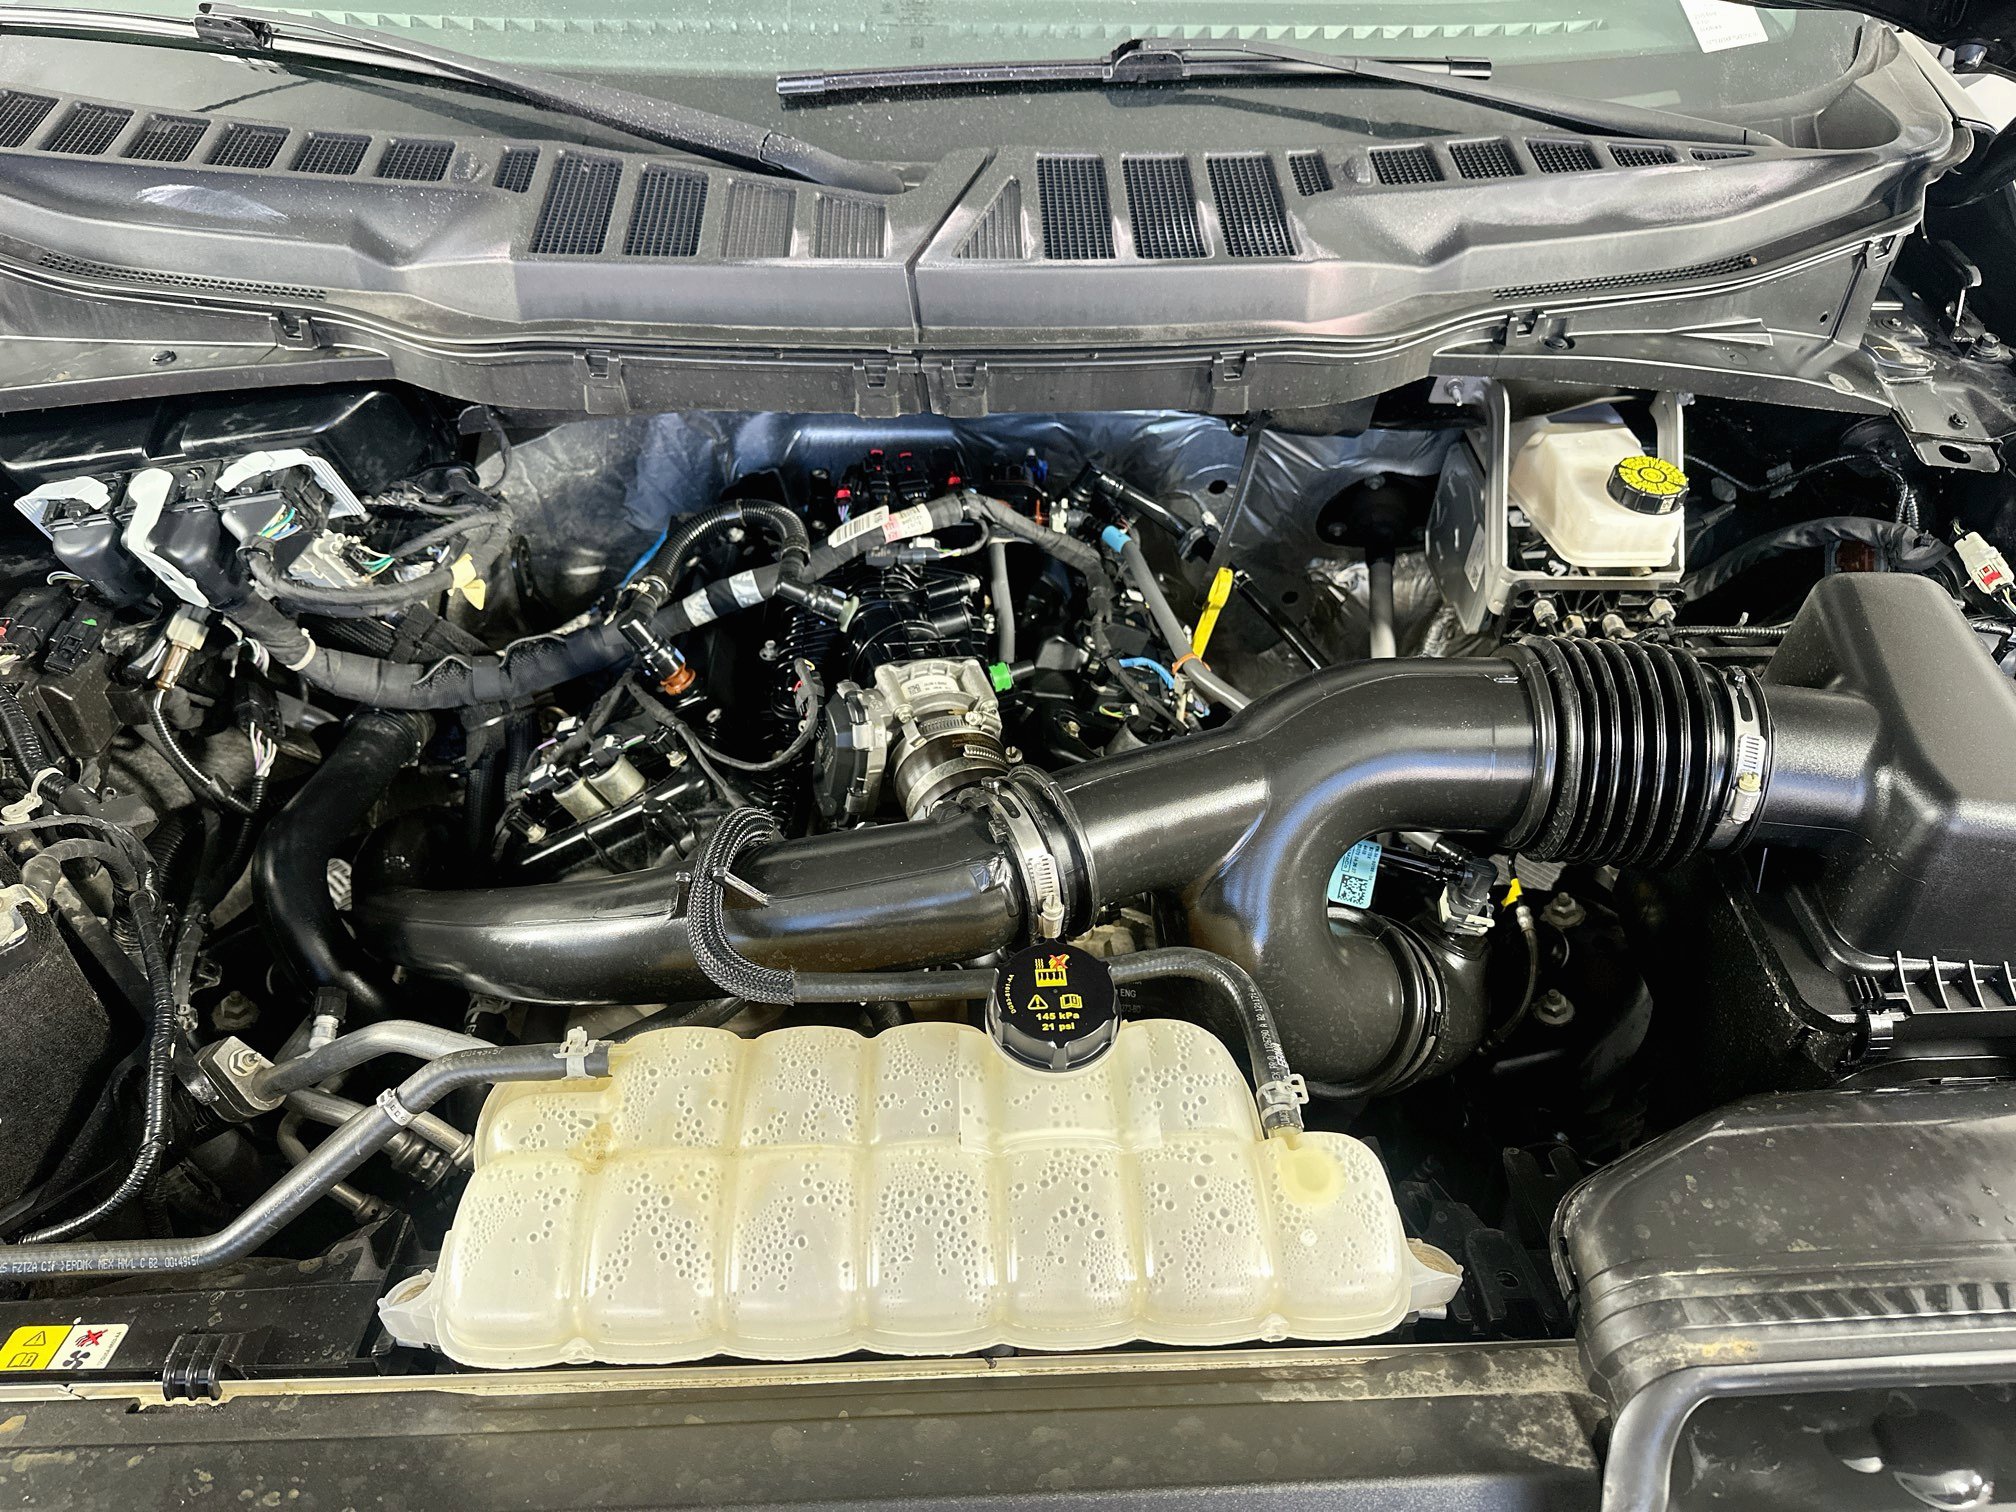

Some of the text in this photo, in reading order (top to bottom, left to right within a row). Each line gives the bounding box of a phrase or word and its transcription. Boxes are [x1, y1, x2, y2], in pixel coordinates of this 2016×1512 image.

[1120, 988, 1137, 998] ENG
[1035, 1012, 1080, 1021] 145 kPa
[1042, 1022, 1075, 1031] 21 psi
